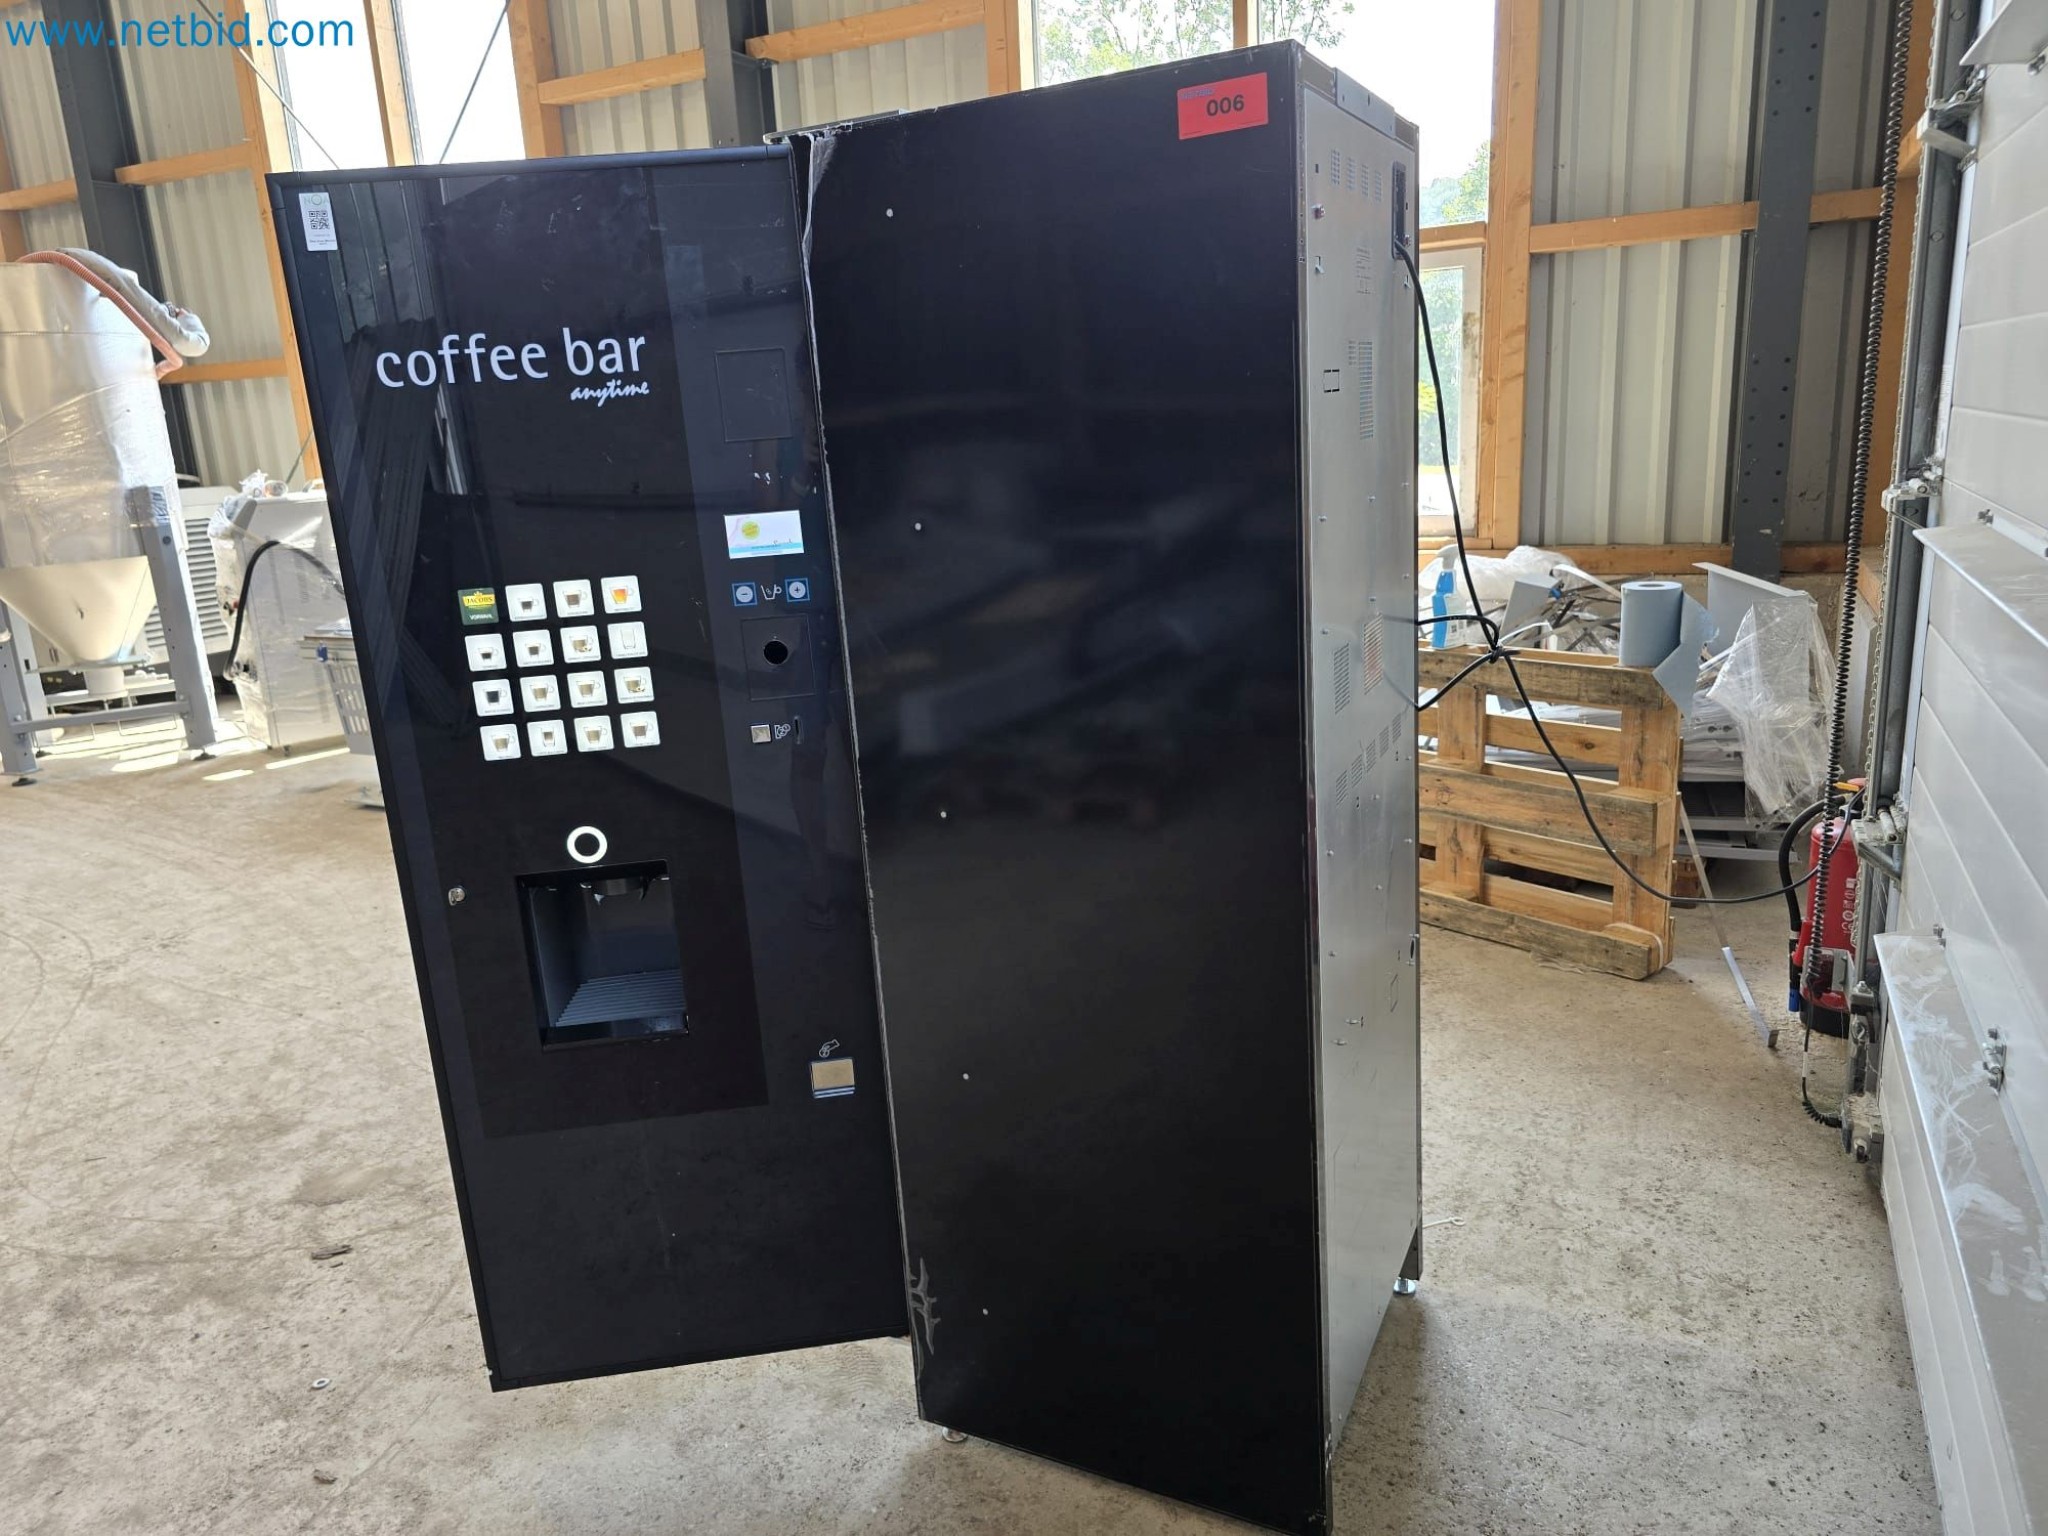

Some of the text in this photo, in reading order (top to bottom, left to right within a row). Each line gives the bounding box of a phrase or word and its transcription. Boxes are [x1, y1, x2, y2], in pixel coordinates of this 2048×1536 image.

[1206, 94, 1245, 116] 006
[376, 327, 646, 388] coffee bar
[570, 379, 650, 408] anytime
[466, 596, 493, 604] JACOBS
